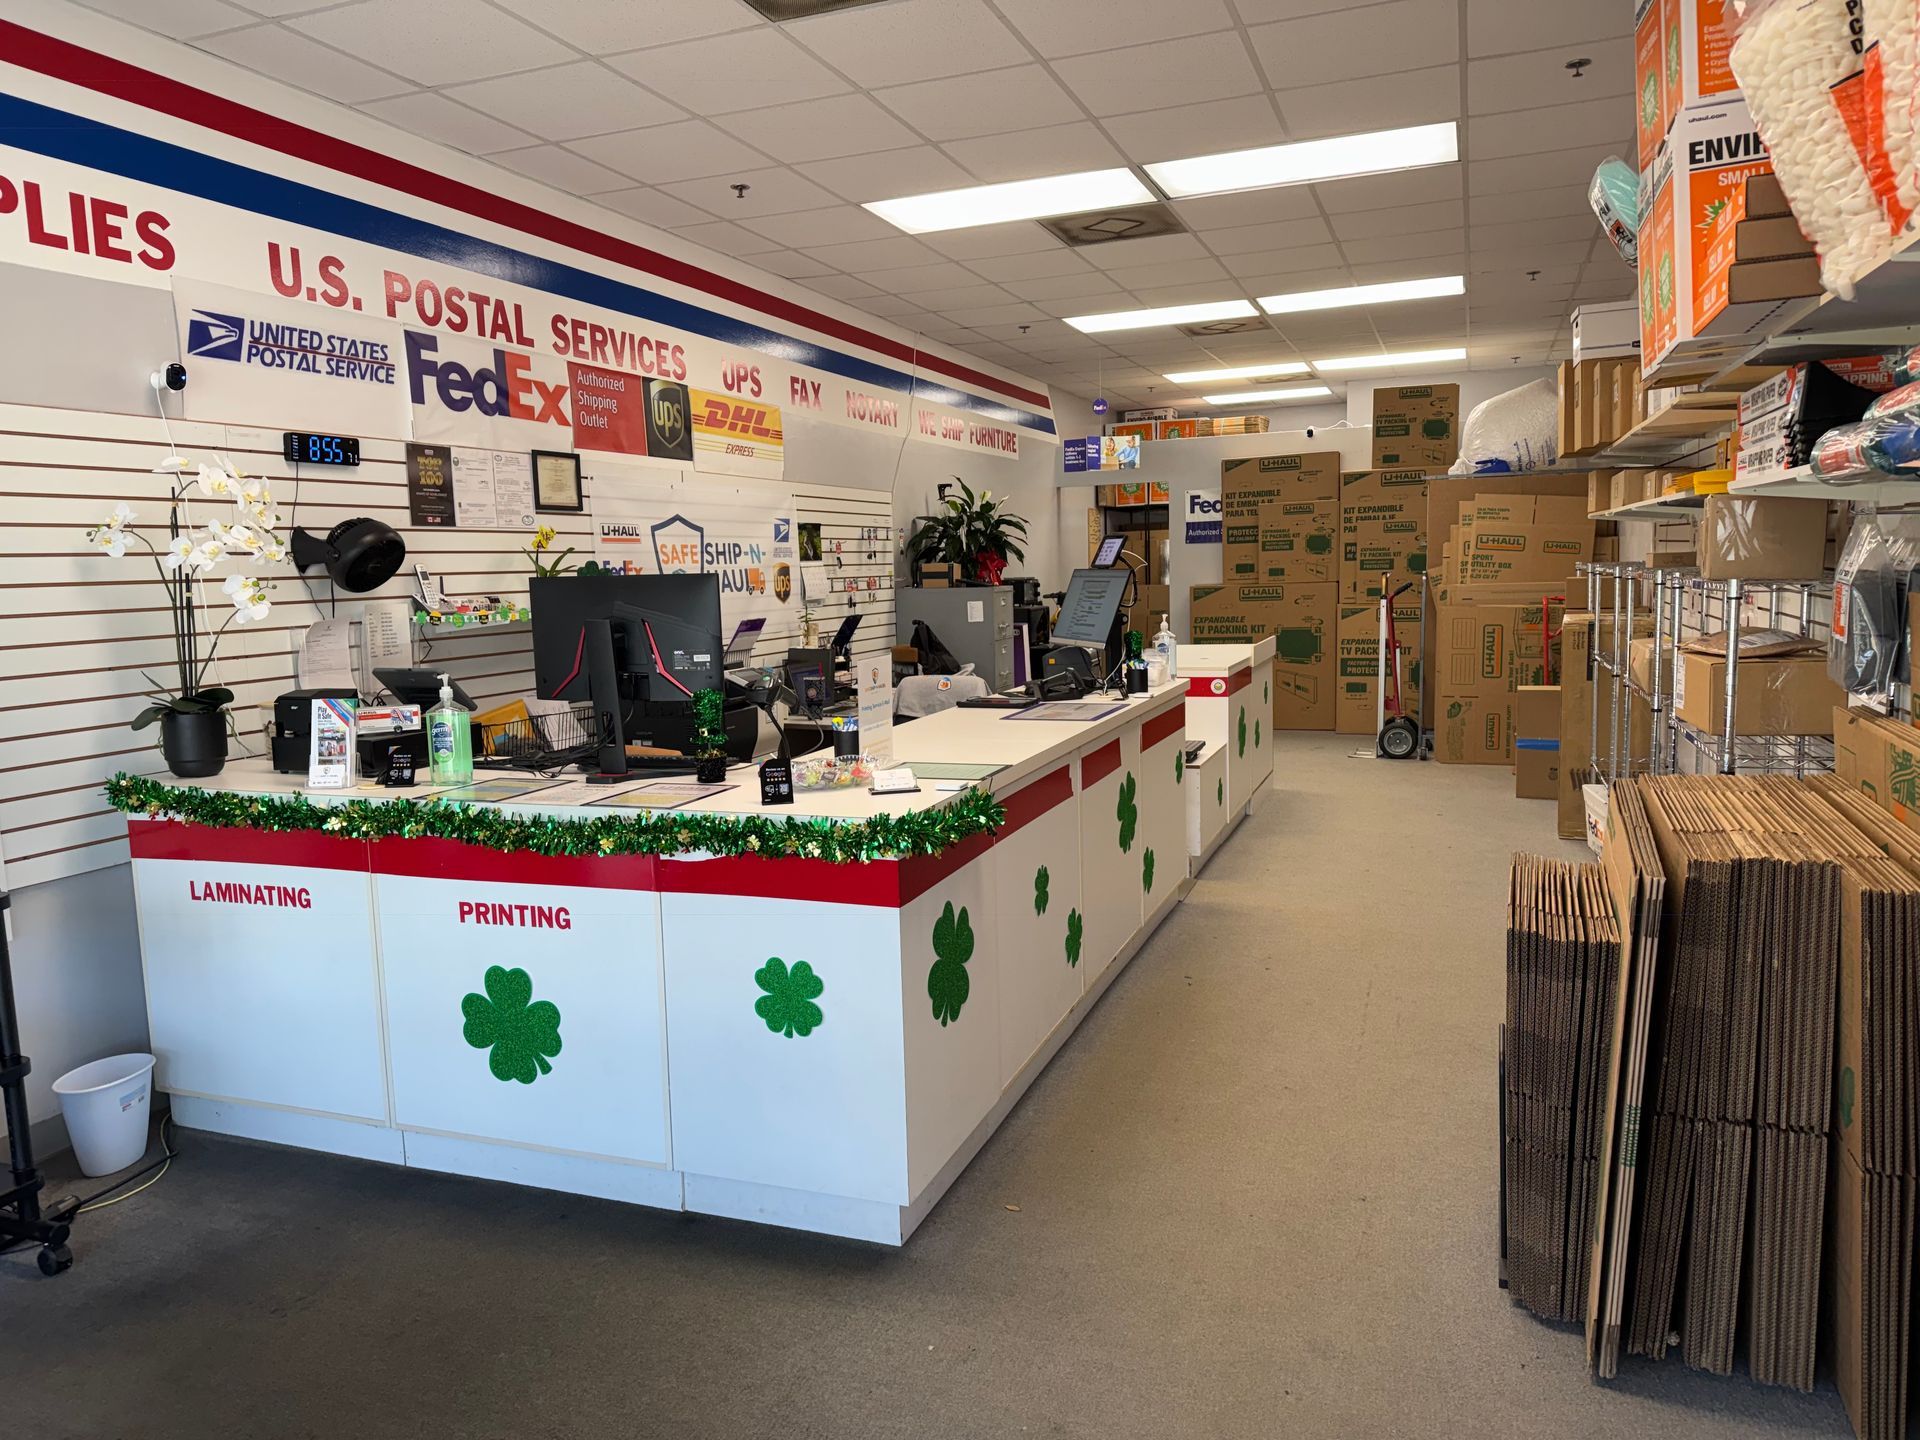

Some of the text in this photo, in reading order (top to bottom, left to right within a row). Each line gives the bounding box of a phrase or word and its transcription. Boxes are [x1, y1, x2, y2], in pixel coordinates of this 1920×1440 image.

[1688, 112, 1728, 123] uhaul.com
[249, 320, 389, 362] UNITED STATES
[268, 241, 363, 311] U.S.
[383, 269, 535, 348] POSTAL
[550, 313, 687, 381] SERVICES
[722, 357, 763, 398] UPS
[790, 376, 822, 410] FAX
[845, 390, 898, 428] NOTARY
[918, 409, 936, 437] WE
[941, 415, 964, 442] SHIP
[969, 422, 1017, 453] FURNITURE
[247, 344, 395, 385] POSTAL SERVICE
[404, 329, 571, 427] FedEx
[577, 370, 624, 392] Authorized
[578, 391, 617, 413] Shipping
[580, 412, 609, 429] Outlet
[654, 399, 681, 438] ups
[704, 399, 770, 438] DHL
[725, 443, 755, 458] EXPRESS
[417, 456, 442, 470] TOP
[1262, 458, 1298, 467] U-HAUL
[419, 471, 443, 486] 100
[1383, 473, 1422, 481] U-HAUL
[1225, 489, 1281, 500] KIT EXPANDIBLE
[1225, 510, 1244, 518] PARA
[1343, 504, 1404, 514] KIT EXPANDIBLE
[1343, 516, 1353, 524] DE
[601, 525, 640, 537] U-HAUL
[1188, 529, 1220, 537] Authorized
[1479, 536, 1522, 545] U-HAUL
[660, 543, 699, 565] SAFE
[603, 560, 643, 575] FedEx
[775, 575, 790, 598] ups
[1241, 588, 1281, 596] U-HAUL
[1194, 616, 1246, 624] EXPANDABLE
[1194, 624, 1266, 634] TV PACKING KIT
[1341, 647, 1352, 655] TV
[1400, 647, 1412, 655] KIT
[1486, 627, 1496, 675] U-HAUL
[318, 706, 327, 714] Play
[190, 880, 312, 909] LAMINATING
[459, 901, 571, 931] PRINTING
